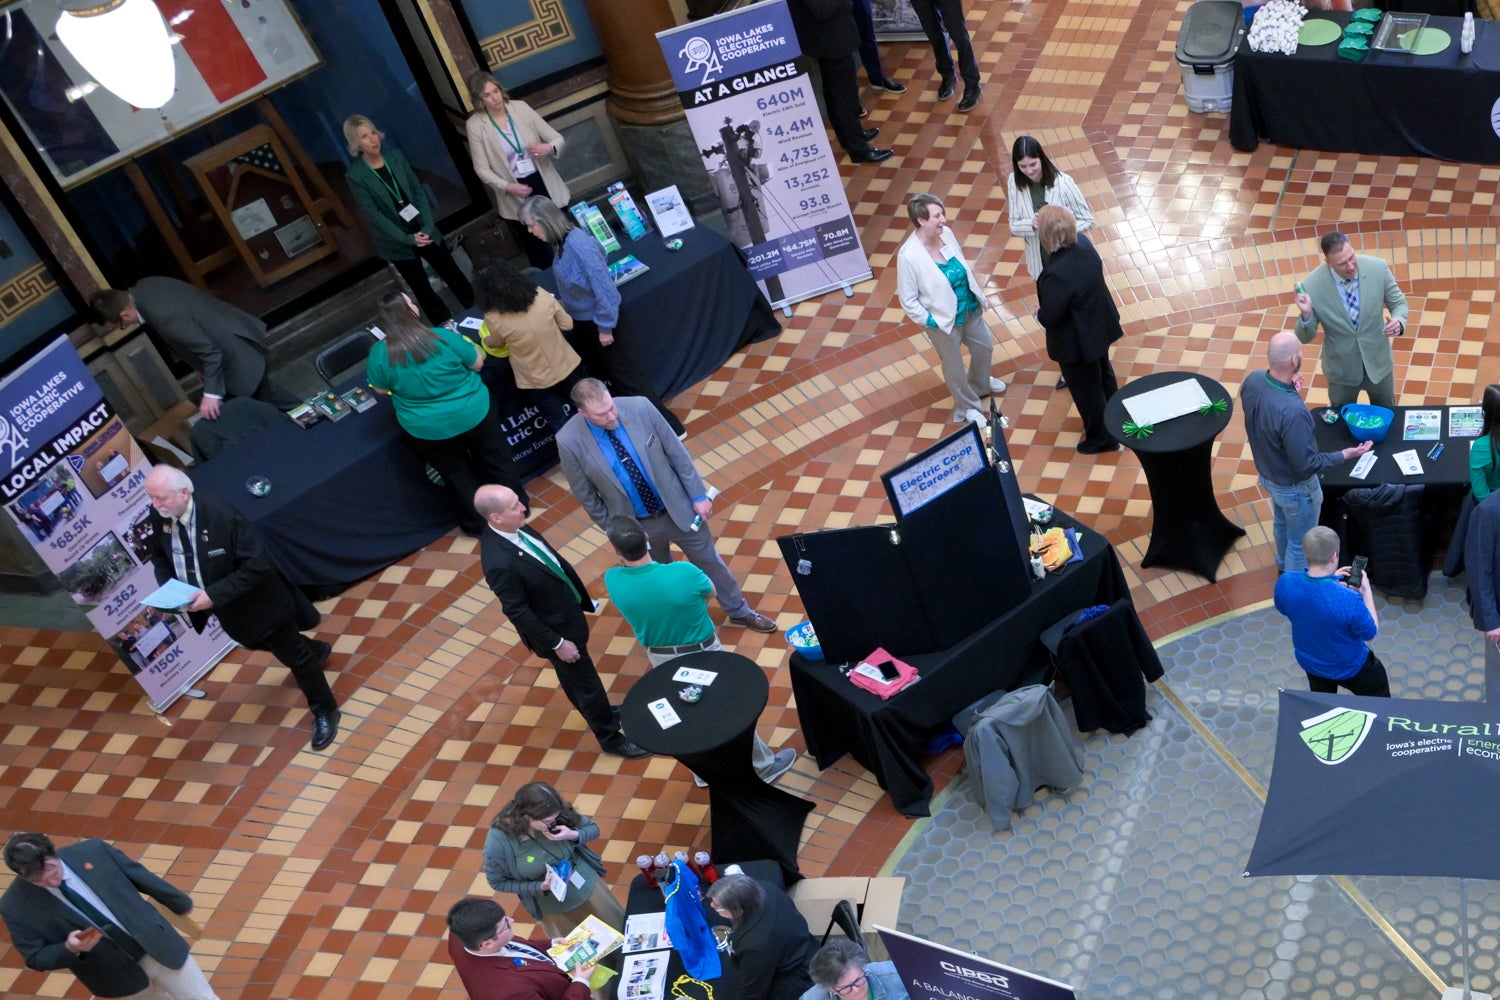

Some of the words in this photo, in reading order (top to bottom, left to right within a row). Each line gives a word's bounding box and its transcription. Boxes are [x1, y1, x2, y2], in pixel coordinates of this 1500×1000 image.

[716, 34, 742, 46] IOWA
[744, 24, 774, 38] LAKES
[718, 35, 763, 54] ELECTRIC
[721, 37, 786, 61] COOPERATIVE
[694, 87, 713, 104] AT
[718, 84, 730, 96] A
[732, 62, 797, 91] GLANCE
[757, 87, 804, 110] 640M
[766, 116, 814, 137] $4.4M
[780, 144, 819, 163] 4,735
[784, 168, 830, 190] 13,252
[800, 194, 830, 211] 93.8
[823, 228, 849, 241] 70.8M
[10, 395, 38, 417] IOWA
[36, 371, 67, 397] LAKES
[21, 381, 85, 433] COOPERATIVE
[15, 389, 60, 426] ELECTRIC
[1, 451, 56, 497] LOCAL
[53, 403, 109, 455] IMPACT
[899, 460, 941, 492] Electric
[942, 445, 973, 466] Co-op
[918, 464, 960, 492] Careers
[111, 469, 146, 500] $3.4M
[50, 515, 92, 550] $68.5K
[103, 583, 138, 617] 2,362
[149, 645, 184, 674] $150K
[1386, 740, 1416, 751] Iowa's
[1417, 738, 1453, 747] electric
[1391, 743, 1453, 758] cooperatives
[912, 978, 923, 988] A
[939, 960, 1009, 989] CIPCO
